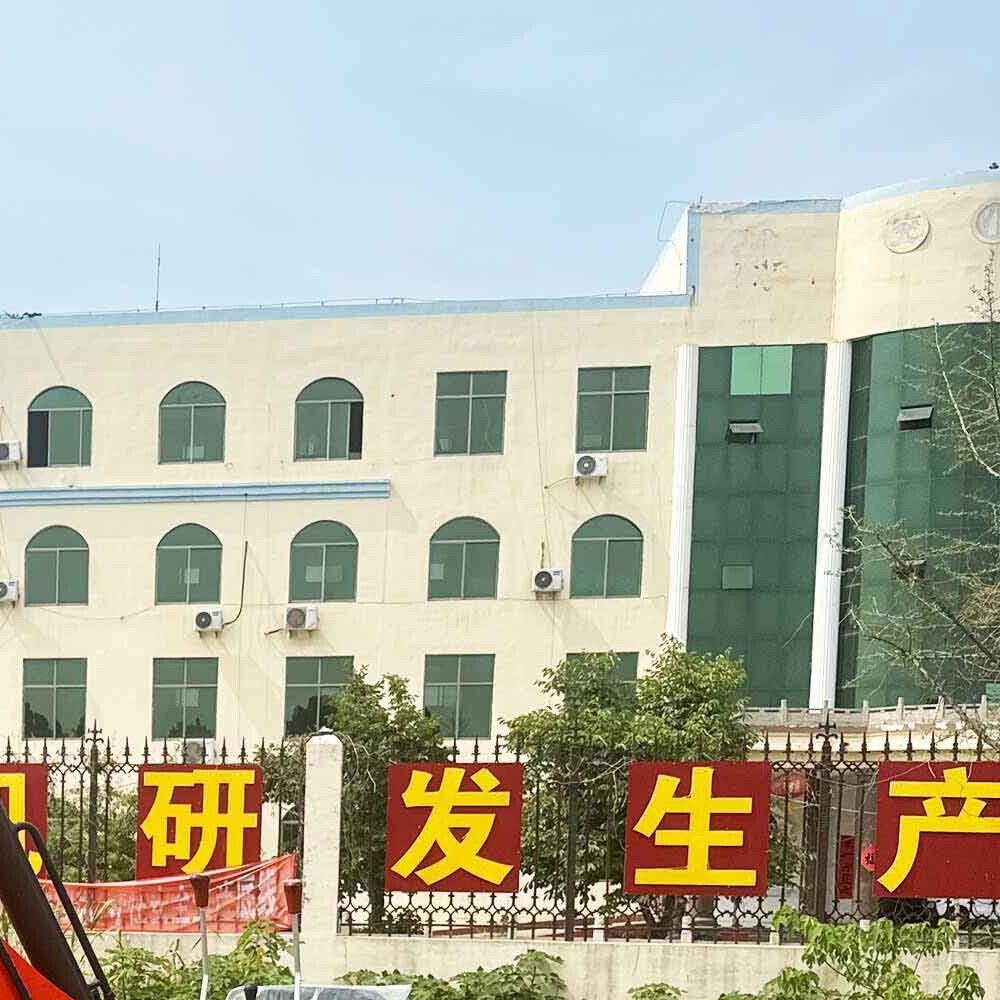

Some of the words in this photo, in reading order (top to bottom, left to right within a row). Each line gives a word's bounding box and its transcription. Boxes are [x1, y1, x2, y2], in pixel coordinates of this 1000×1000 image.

[140, 769, 258, 875] 研
[391, 767, 514, 885] 发
[633, 767, 757, 886] 生
[877, 767, 1000, 893] 产
